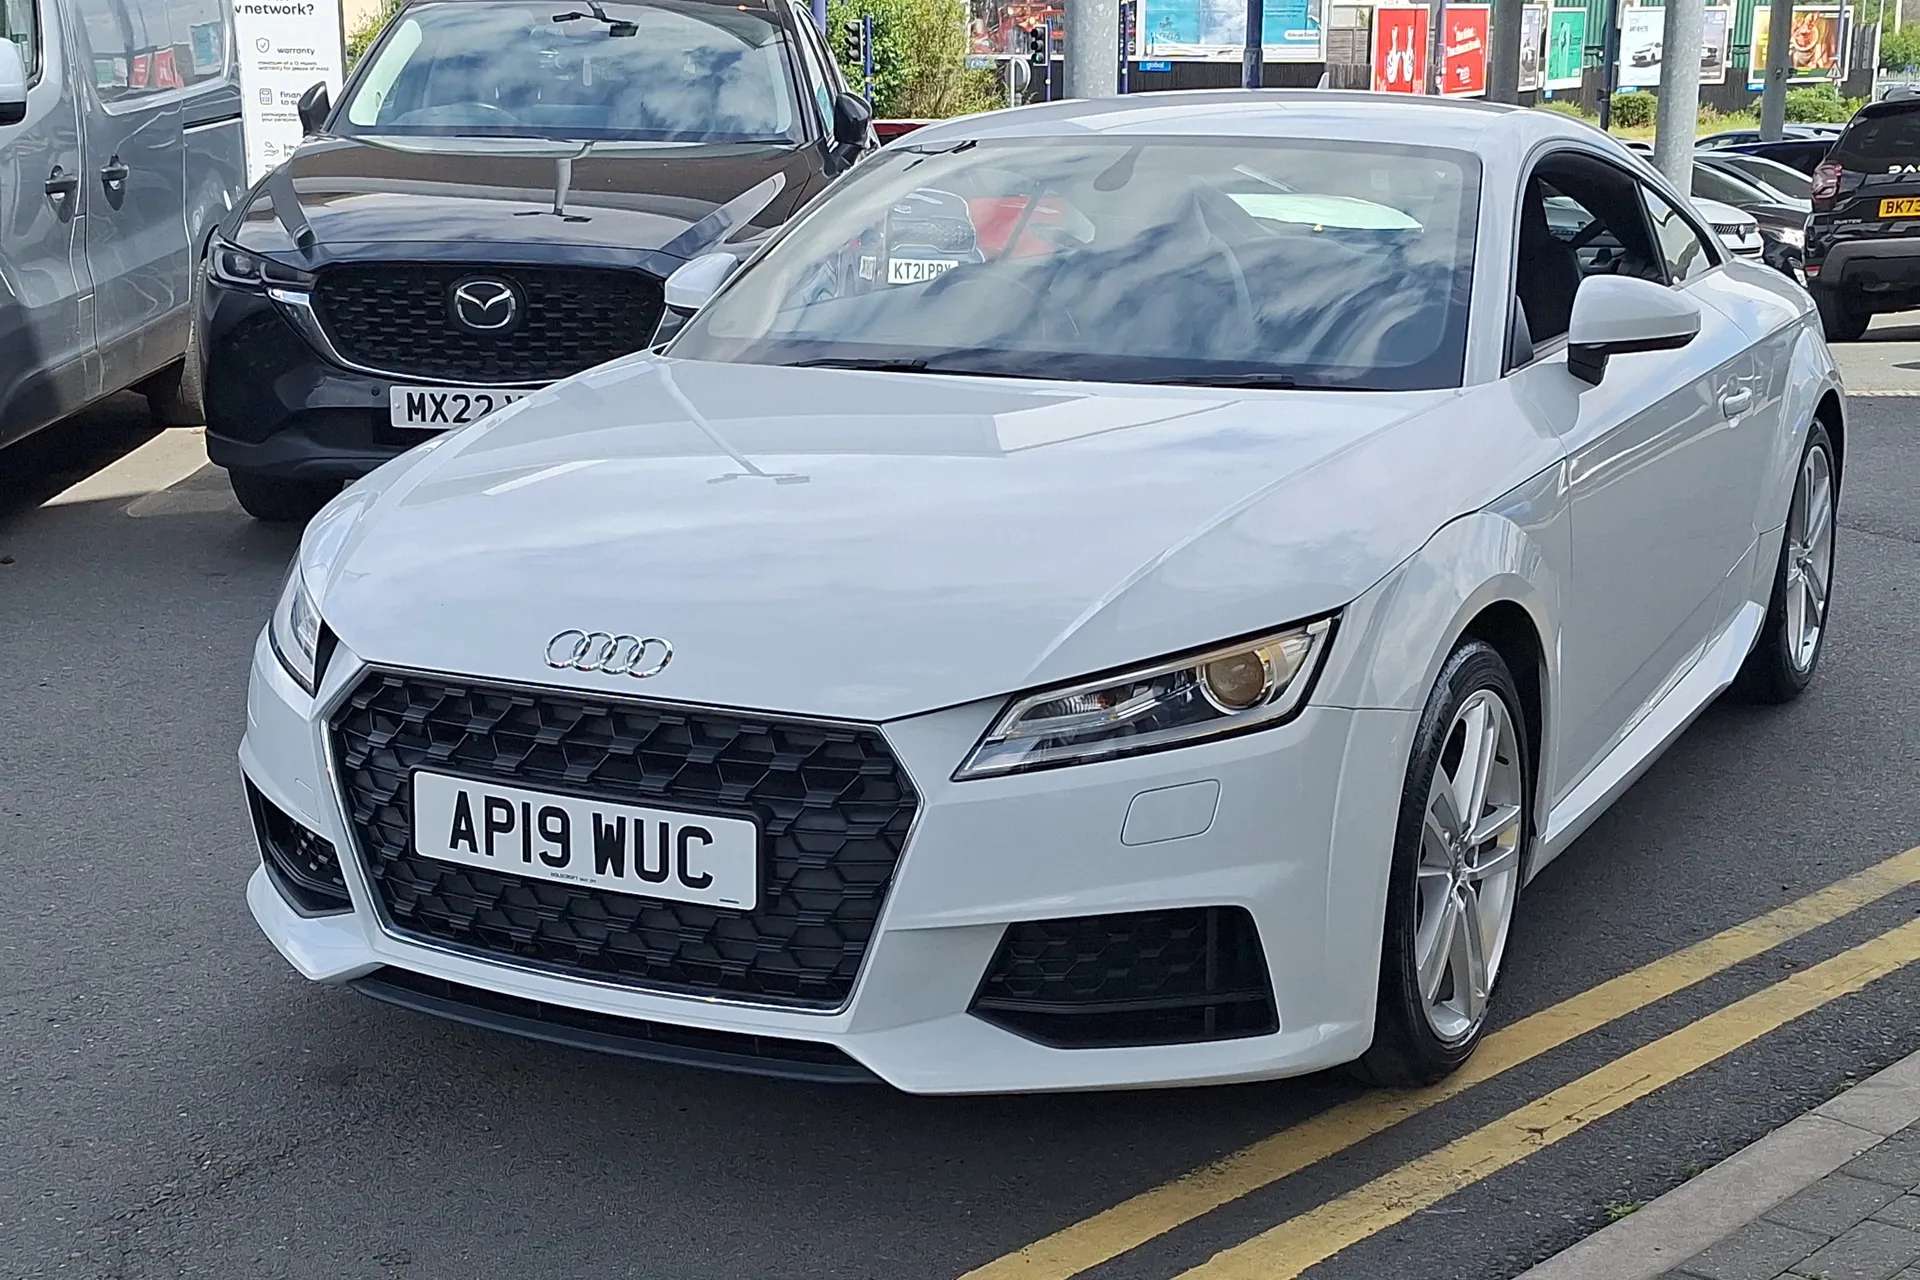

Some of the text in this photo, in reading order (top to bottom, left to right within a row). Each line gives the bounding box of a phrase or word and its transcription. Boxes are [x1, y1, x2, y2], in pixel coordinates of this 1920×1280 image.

[245, 3, 314, 15] network?
[280, 91, 301, 99] finan
[1888, 164, 1920, 174] DA
[894, 262, 925, 280] KT21
[406, 392, 494, 424] MX22
[449, 790, 714, 890] AP19 WUC
